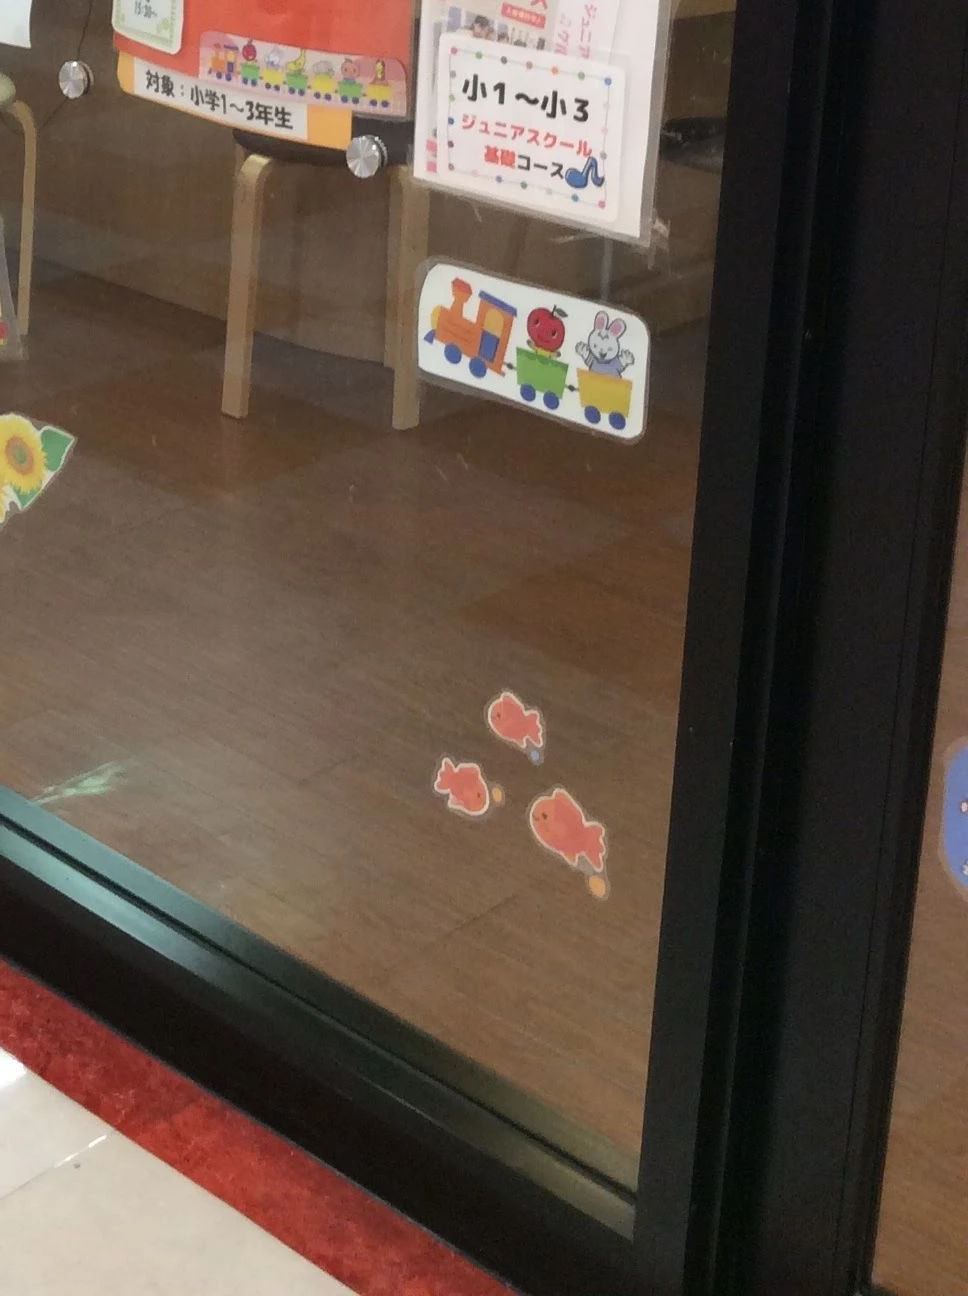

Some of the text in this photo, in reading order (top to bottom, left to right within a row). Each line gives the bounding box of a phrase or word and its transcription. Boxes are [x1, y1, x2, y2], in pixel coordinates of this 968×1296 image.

[145, 70, 294, 130] 対象：小学1～3年生
[462, 73, 590, 123] 小1～小3
[461, 113, 593, 158] ジュニアスクール
[483, 144, 565, 181] 基礎コース
